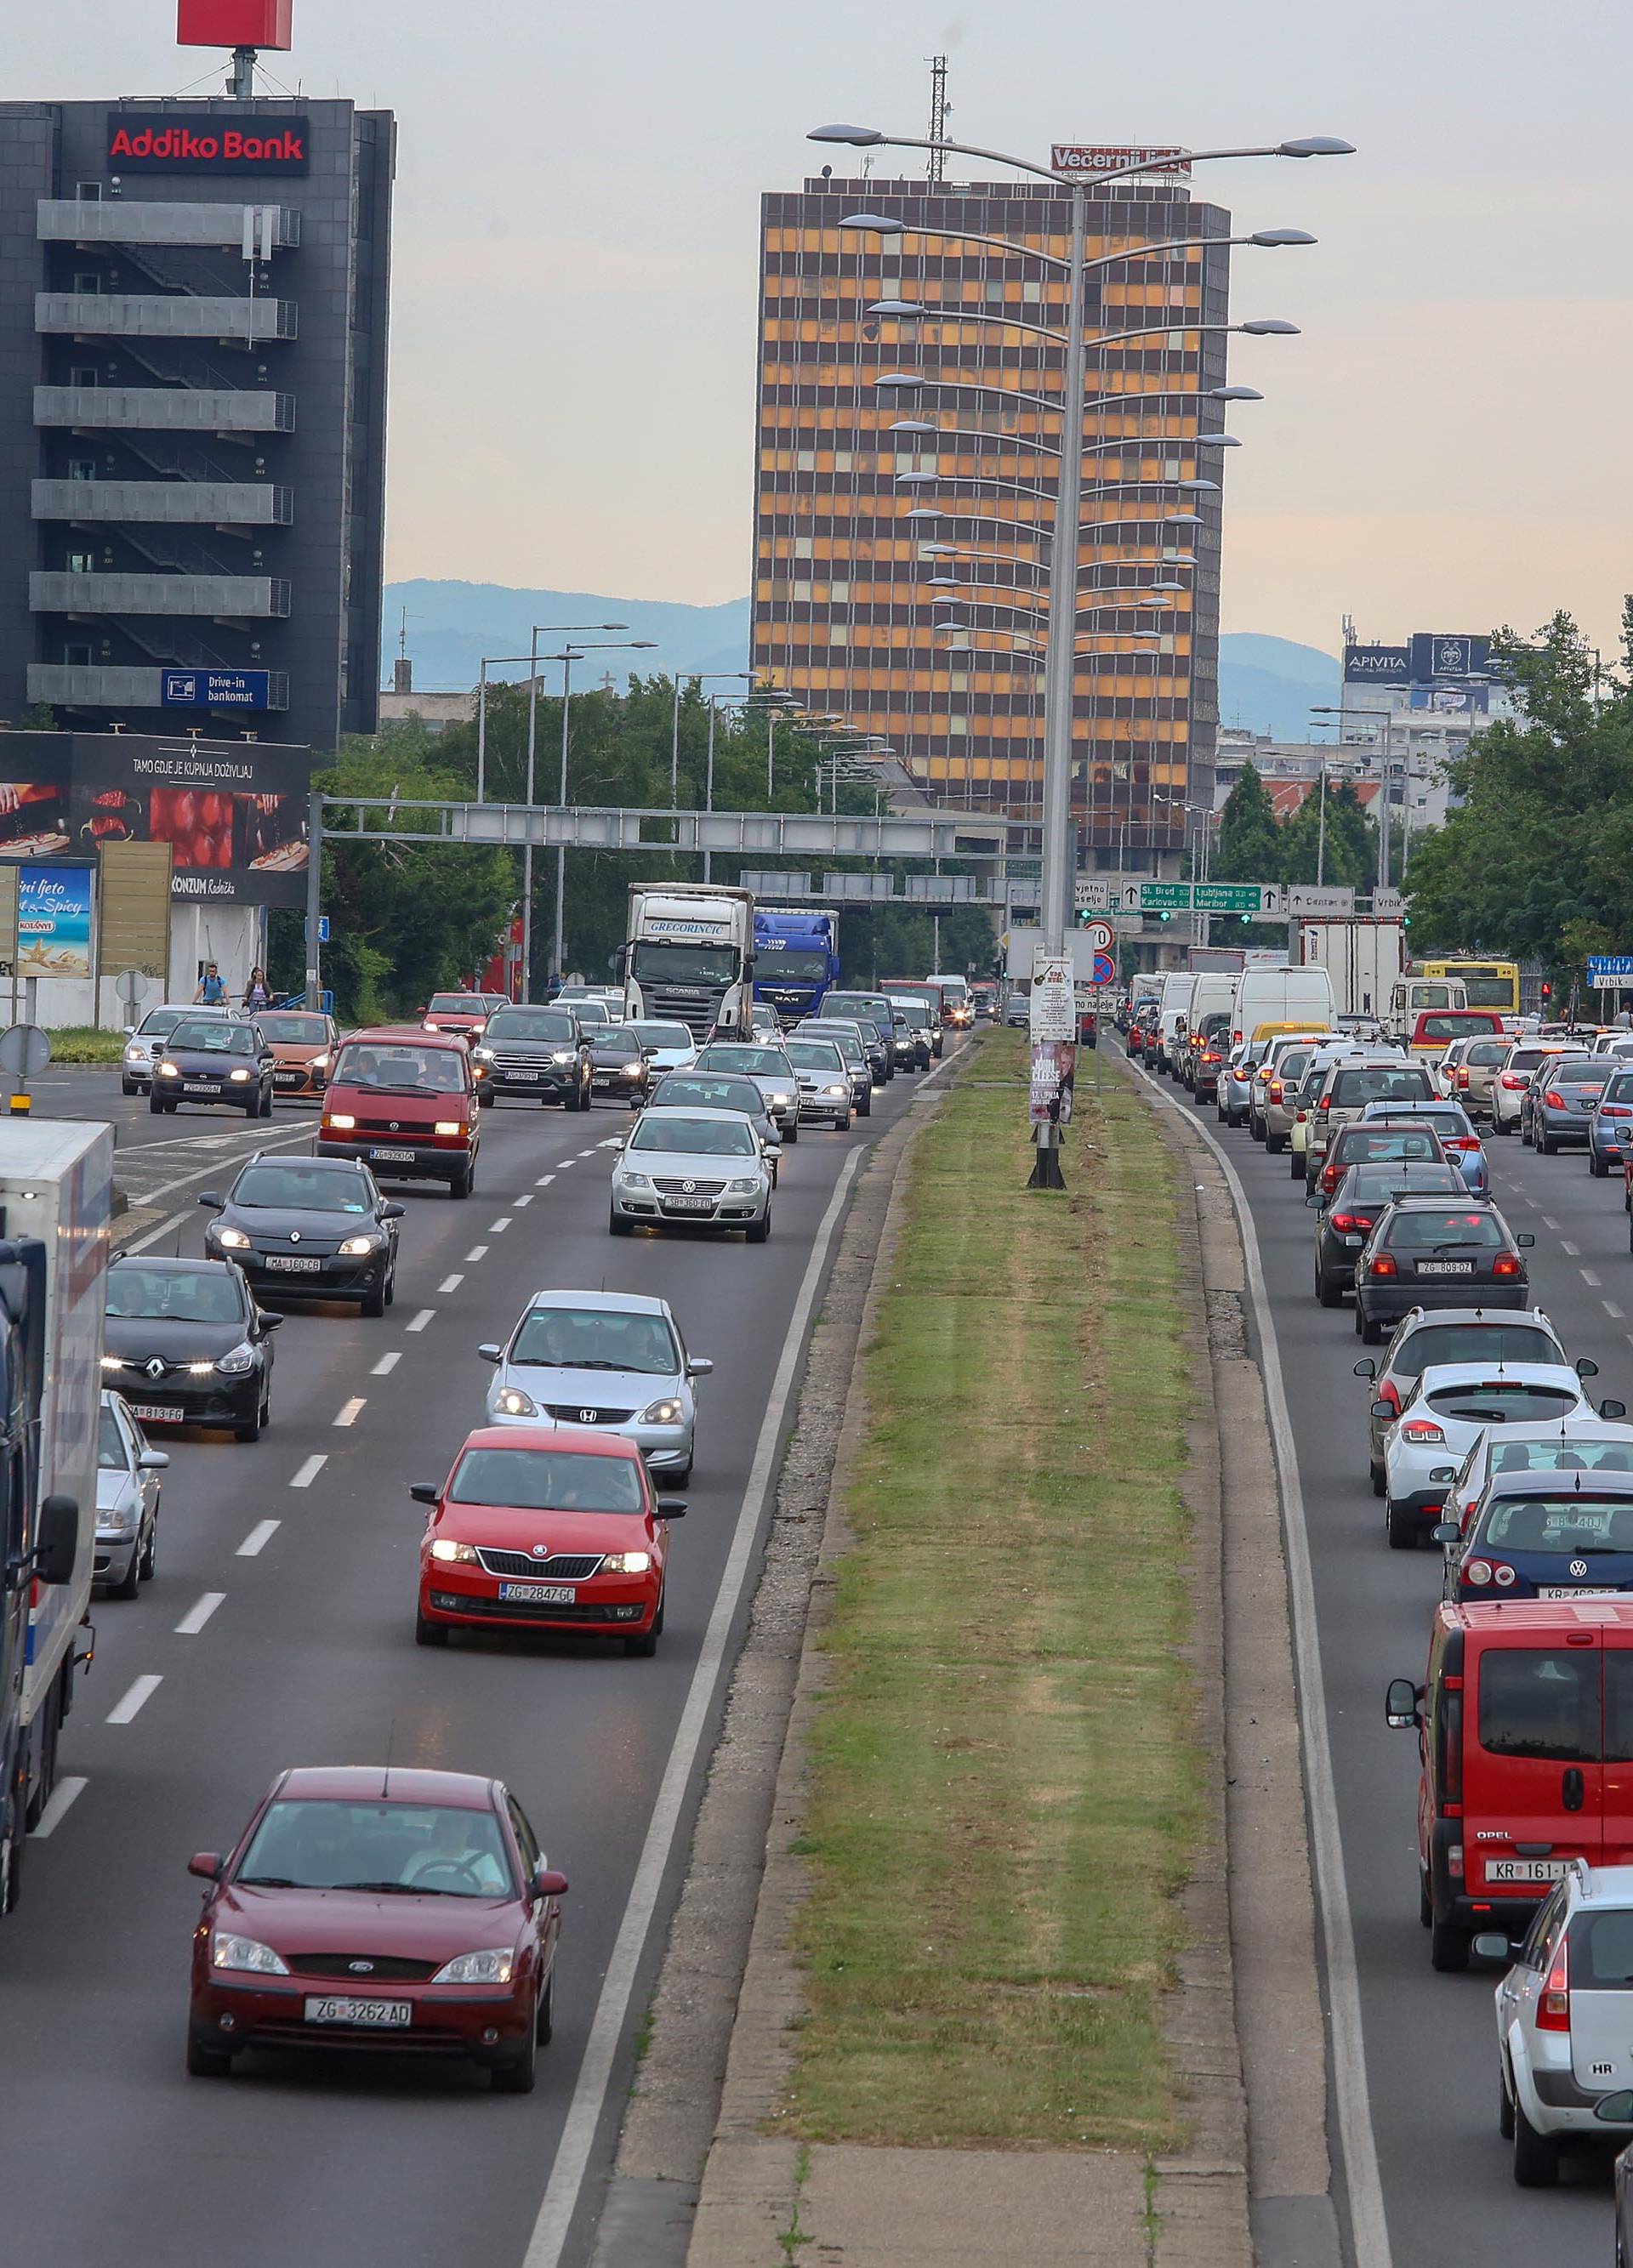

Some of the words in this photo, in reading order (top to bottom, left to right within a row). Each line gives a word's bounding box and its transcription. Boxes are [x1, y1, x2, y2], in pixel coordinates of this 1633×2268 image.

[110, 128, 219, 159] Addiko
[224, 130, 304, 160] Bank
[1053, 148, 1141, 168] Večernji
[1349, 656, 1407, 668] APIVITA
[208, 676, 245, 689] Drive-in
[208, 690, 253, 702] bankomat
[133, 759, 153, 774] TAMO
[154, 759, 173, 775] GDJE
[174, 761, 183, 776] JE
[184, 762, 213, 777] KUPNJA
[214, 762, 253, 779] DOŽIVLJAJ
[37, 878, 65, 899] ljeto
[171, 874, 207, 895] KONZUM
[1075, 884, 1105, 894] vjetno
[1155, 886, 1175, 895] Brod
[1196, 887, 1233, 898] Ljubljana
[1074, 895, 1102, 905] aselje
[1141, 897, 1178, 907] Karlovac
[1196, 899, 1227, 907] Maribor
[43, 898, 83, 918] Spicy
[651, 921, 724, 935] GREGORINČIĆ
[1599, 976, 1624, 986] Vrbik
[665, 986, 700, 996] SCANIA
[1087, 999, 1113, 1011] naelje
[1032, 1070, 1061, 1082] CLEESE
[272, 1259, 282, 1267] MA
[1425, 1263, 1435, 1272] ZG
[146, 1407, 181, 1420] 813-FG
[508, 1585, 522, 1599] ZG
[1477, 1831, 1512, 1839] OPEL
[1496, 1863, 1514, 1879] KR
[1528, 1863, 1573, 1879] 161-
[317, 2000, 336, 2018] ZG
[347, 2003, 408, 2022] 3262-AD
[1592, 2064, 1612, 2074] HR
